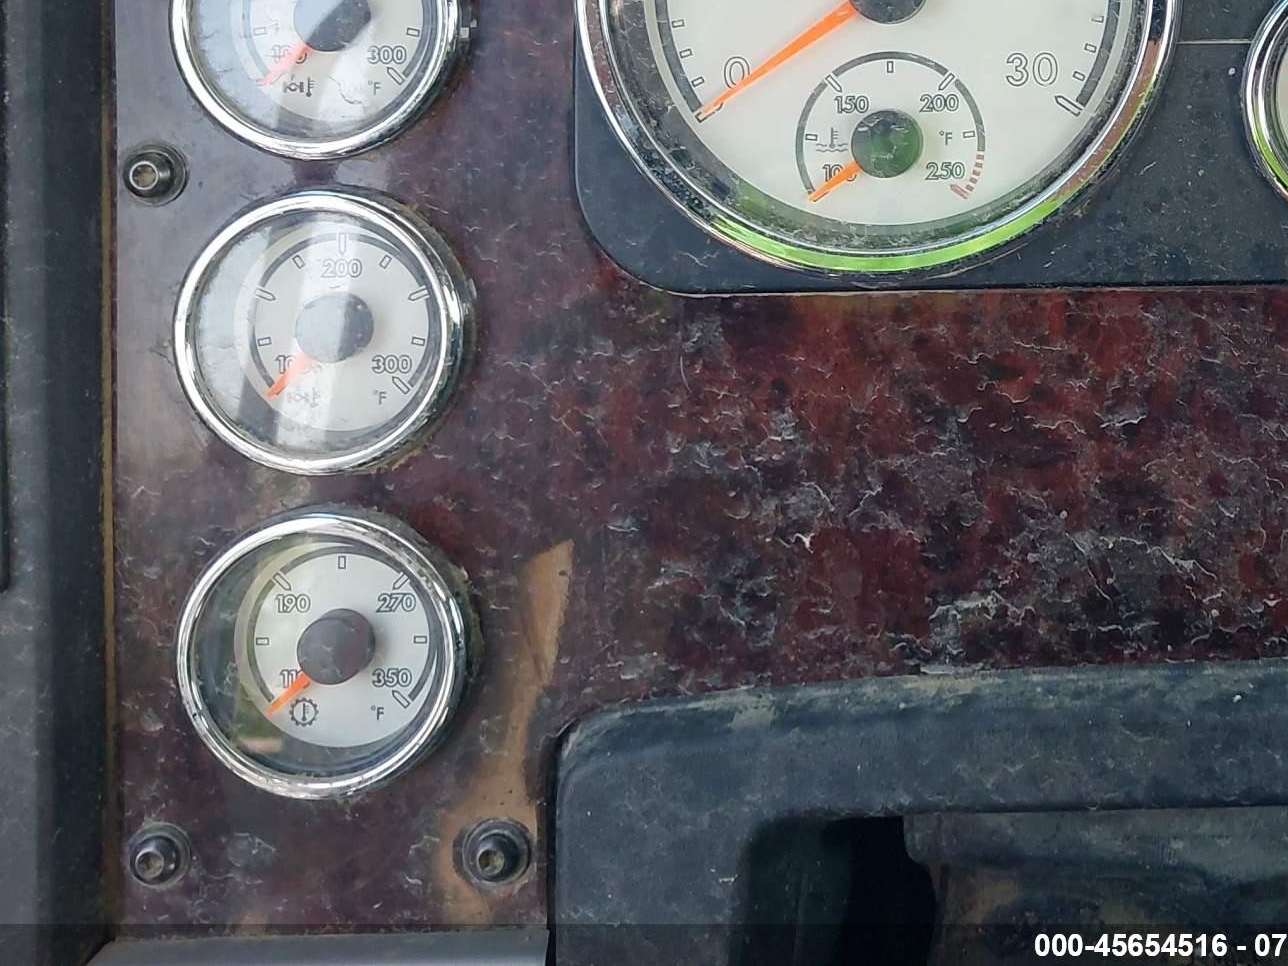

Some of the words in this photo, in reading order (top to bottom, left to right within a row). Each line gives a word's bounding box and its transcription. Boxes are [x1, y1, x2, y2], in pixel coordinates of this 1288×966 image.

[368, 46, 407, 64] 300
[724, 56, 750, 91] 0
[1005, 52, 1058, 87] 30
[834, 96, 869, 114] 150
[919, 94, 959, 113] 200
[925, 162, 965, 180] 250
[321, 259, 362, 278] 200
[372, 355, 412, 373] 300
[275, 594, 310, 613] 190
[376, 594, 416, 612] 270
[372, 669, 412, 687] 350
